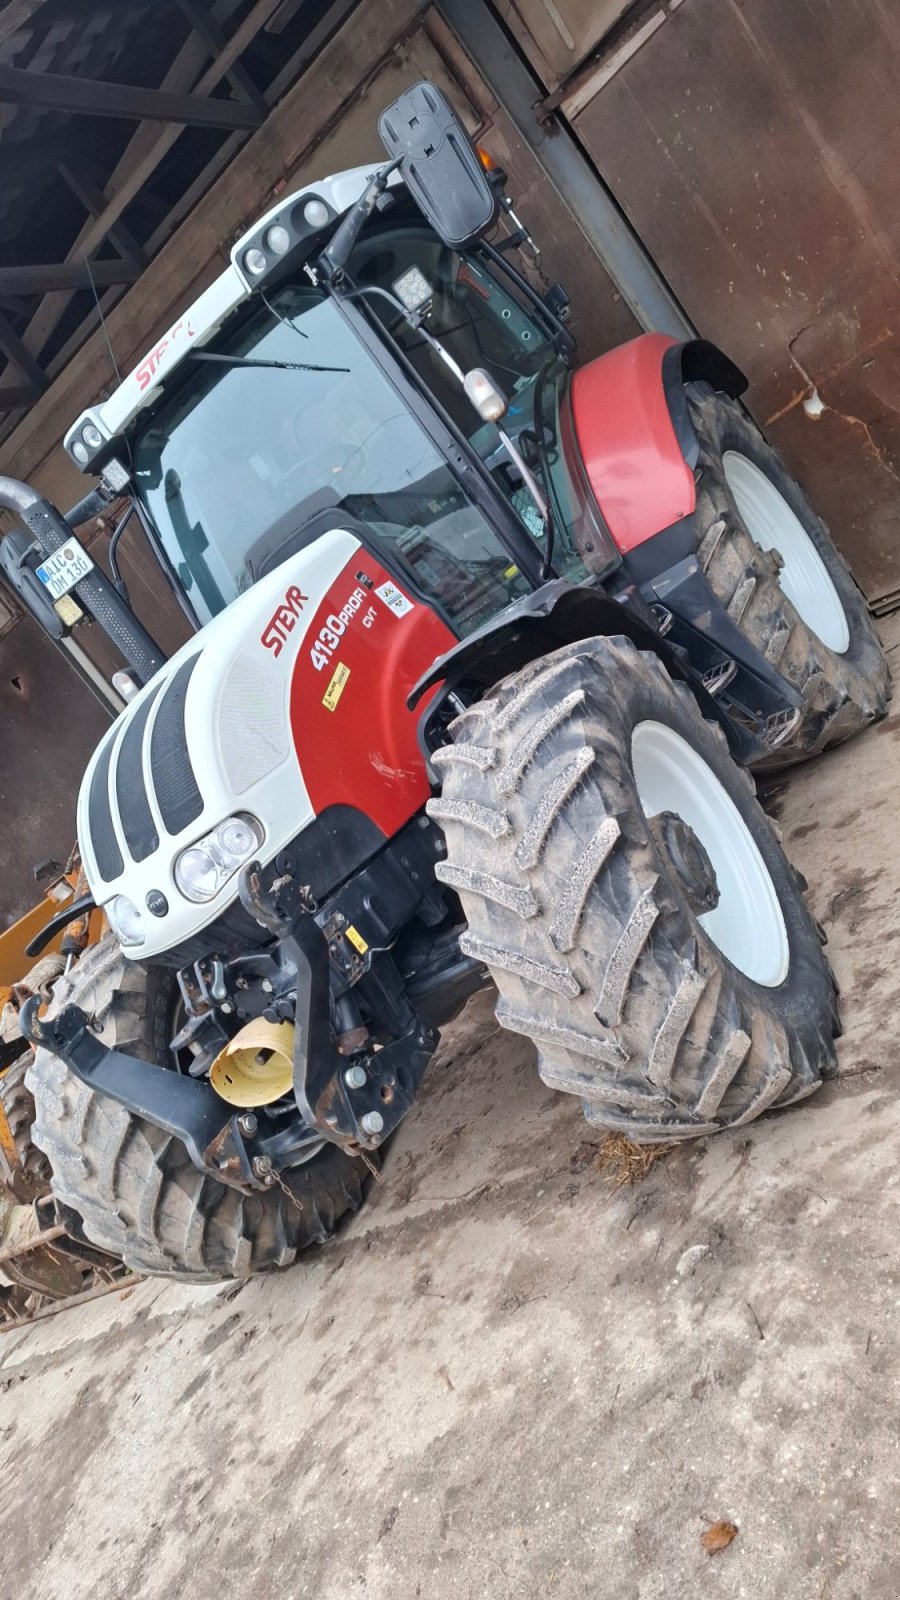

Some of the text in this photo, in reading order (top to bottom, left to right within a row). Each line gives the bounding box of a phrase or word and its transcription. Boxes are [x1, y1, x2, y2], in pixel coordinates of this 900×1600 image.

[45, 554, 67, 577] AIC
[50, 555, 88, 594] DM 130
[261, 585, 309, 658] STEYR
[310, 587, 367, 671] 4130 PROFI
[362, 606, 378, 629] CVT
